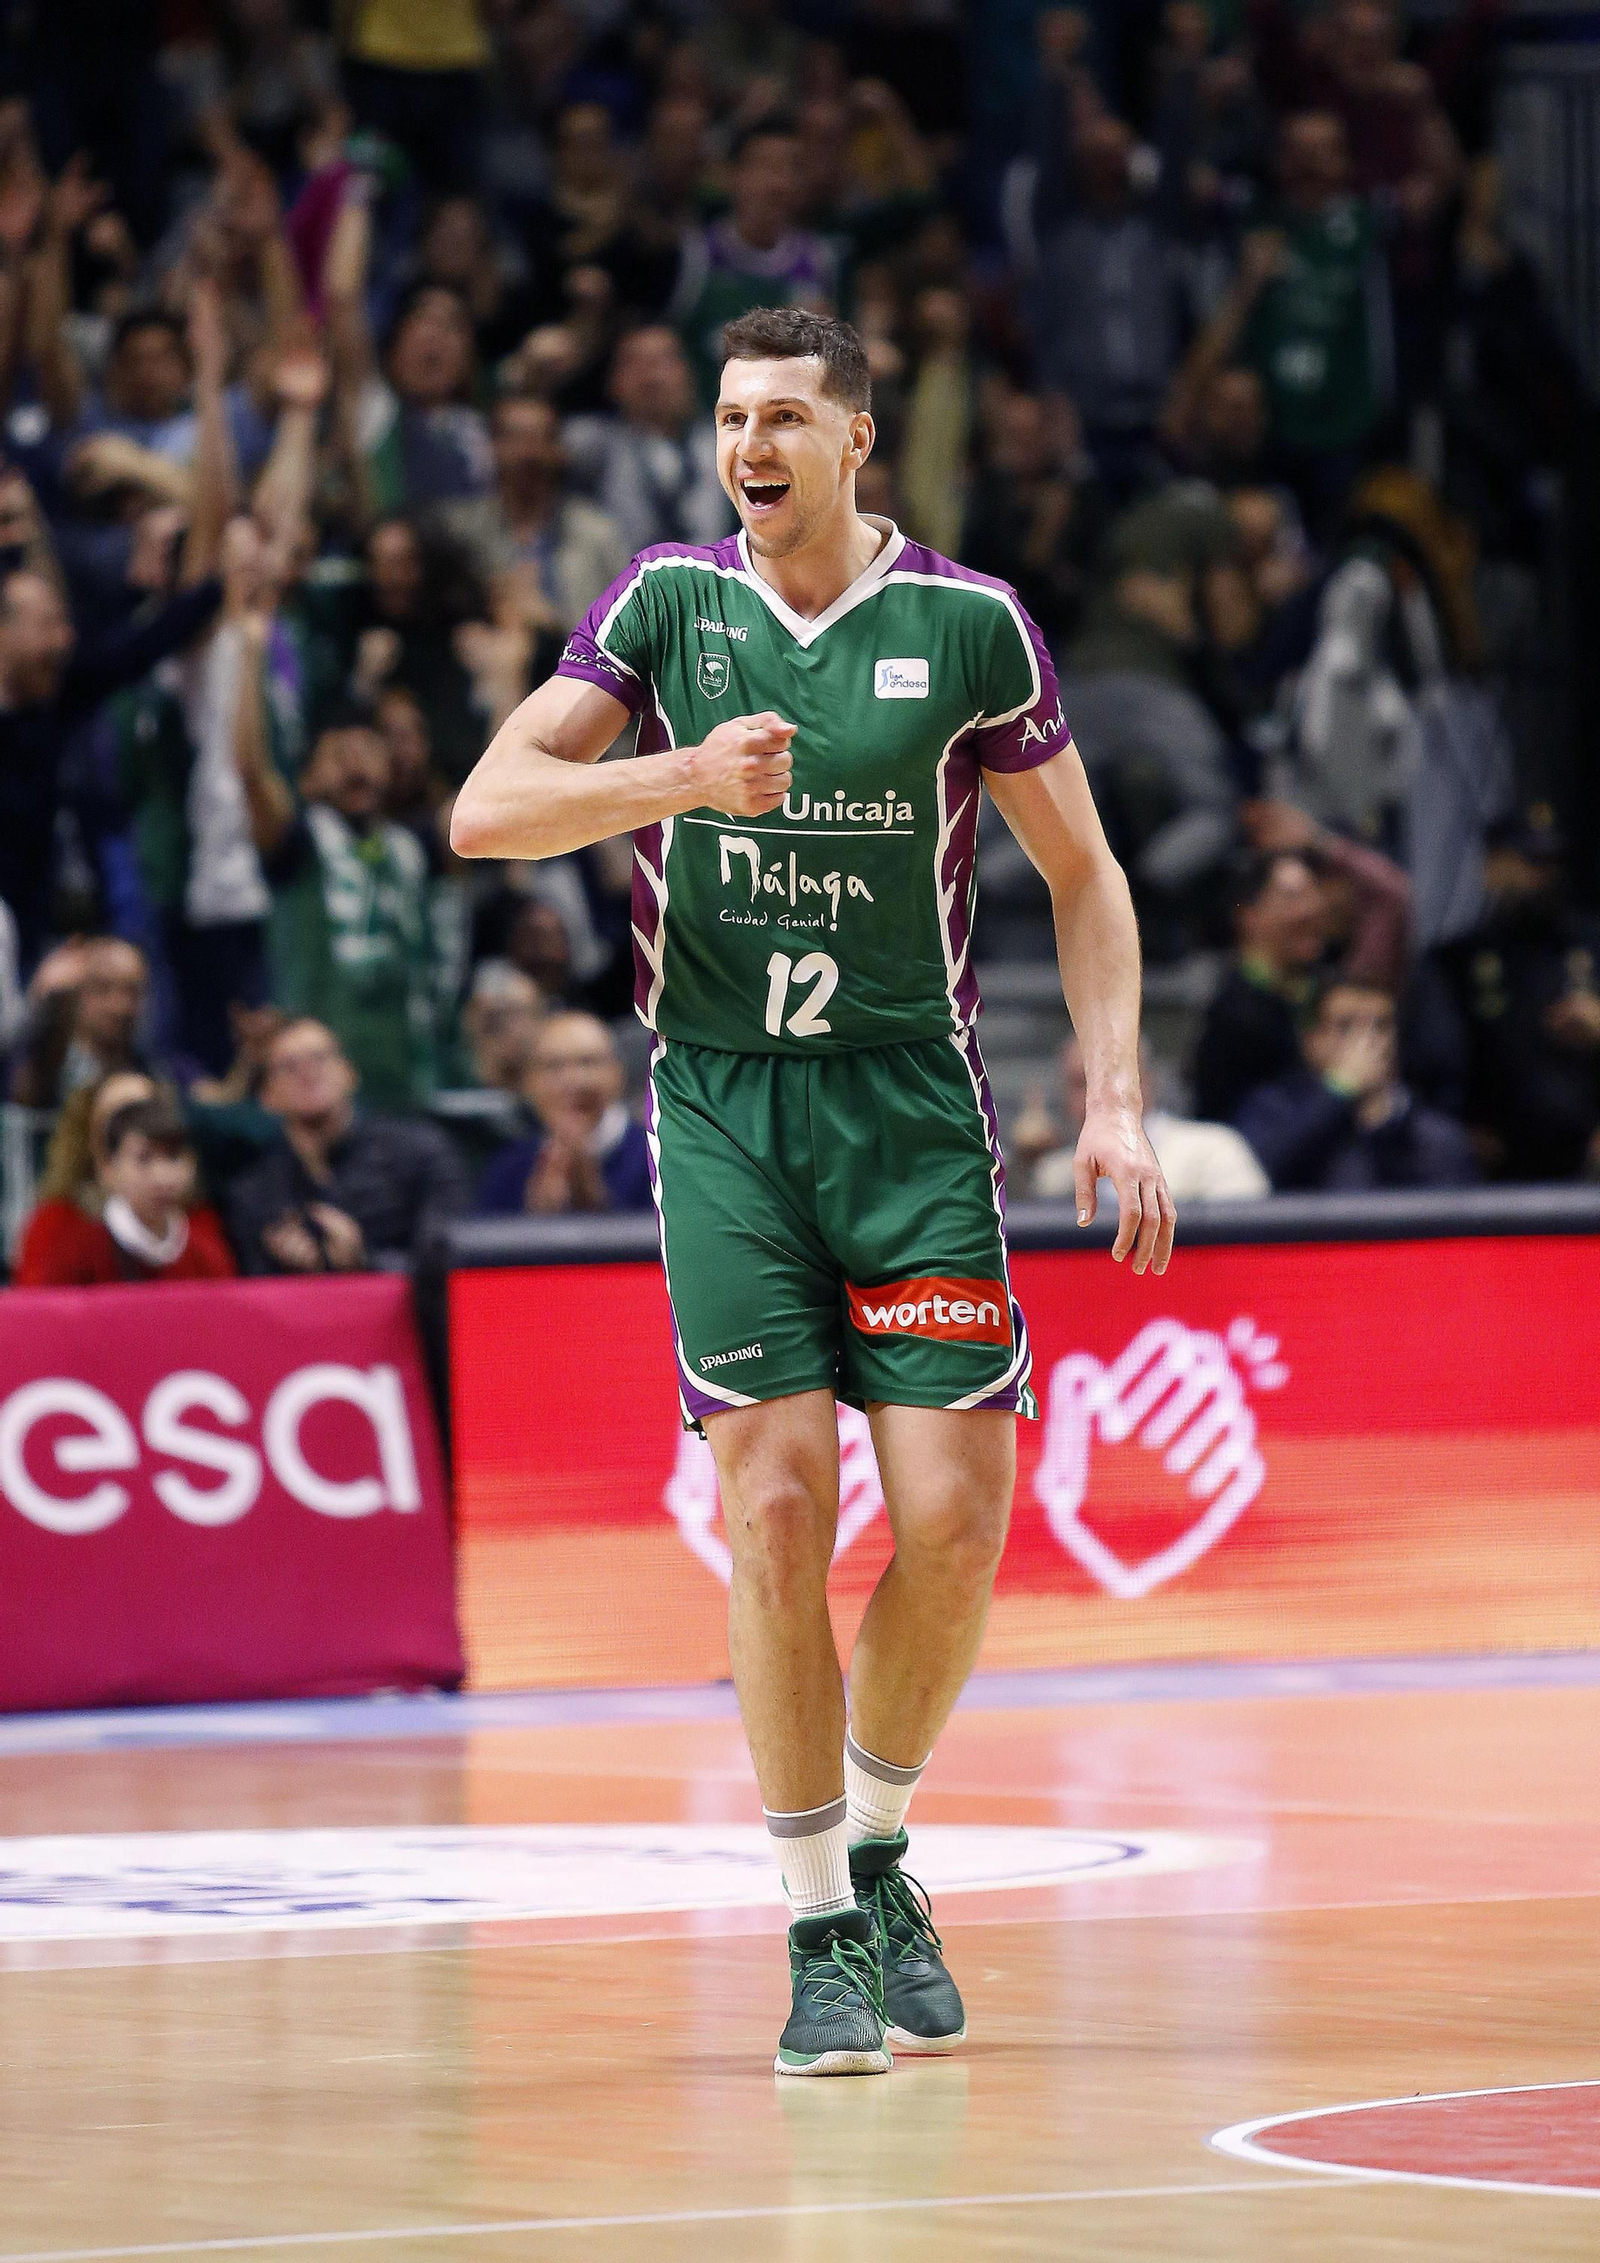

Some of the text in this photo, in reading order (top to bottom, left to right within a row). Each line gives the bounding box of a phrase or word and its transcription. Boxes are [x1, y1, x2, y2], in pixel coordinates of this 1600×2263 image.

[889, 679, 927, 689] endesa
[781, 789, 915, 829] Unicaja
[719, 908, 769, 927] Ciudad
[765, 951, 839, 1037] 12
[861, 1294, 1000, 1329] worten
[699, 1342, 764, 1373] SPALDING
[0, 1362, 425, 1537] esa
